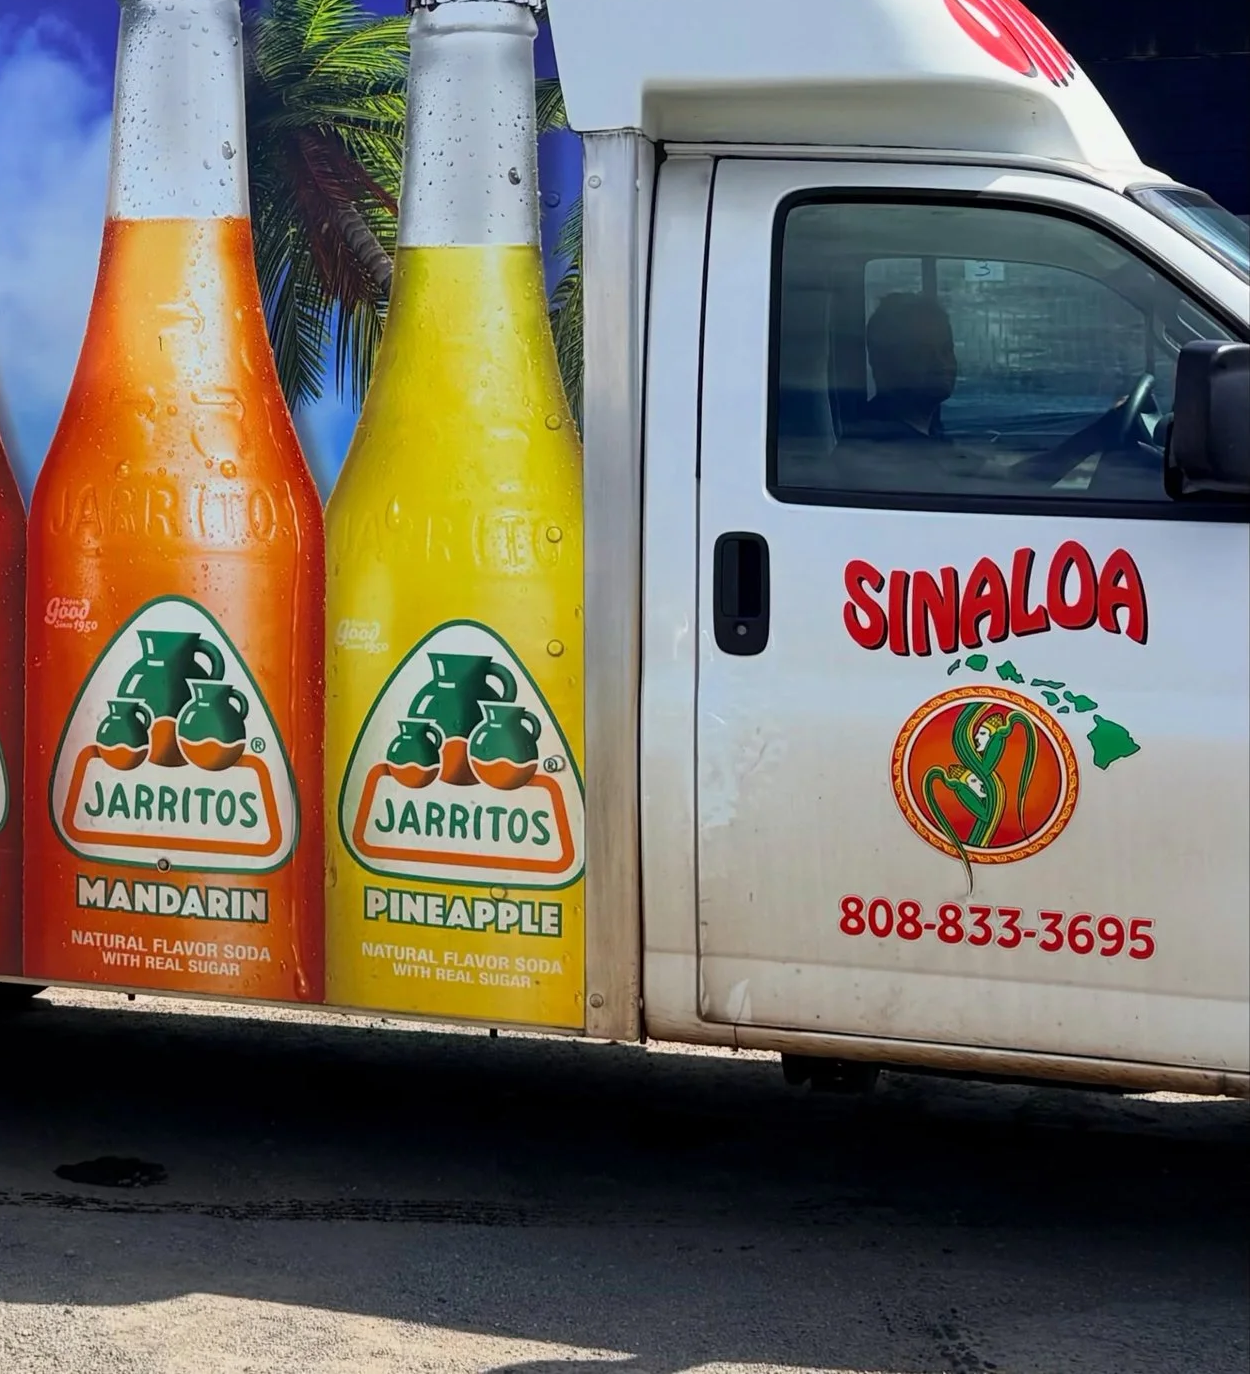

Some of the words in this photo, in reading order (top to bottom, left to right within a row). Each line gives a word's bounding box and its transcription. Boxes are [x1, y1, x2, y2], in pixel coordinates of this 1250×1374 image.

[843, 540, 1148, 657] SINALOA
[73, 619, 98, 633] 1950
[84, 781, 258, 828] JARRITOS
[375, 798, 550, 846] JARRITOS
[76, 873, 268, 923] MANDARIN
[363, 885, 562, 938] PINEAPPLE
[71, 929, 148, 952] NATURAL
[152, 938, 218, 958] FLAVOR
[223, 944, 271, 962] SODA
[839, 895, 1156, 960] 808-833-3695
[102, 950, 140, 968] WITH
[145, 955, 184, 972] REAL
[188, 959, 241, 976] SUGAR
[362, 942, 438, 964] NATURAL
[443, 951, 509, 971] FLAVOR
[515, 956, 563, 975] SODA
[392, 962, 431, 979] WITH
[435, 967, 475, 984] REAL
[479, 971, 531, 988] SUGAR
